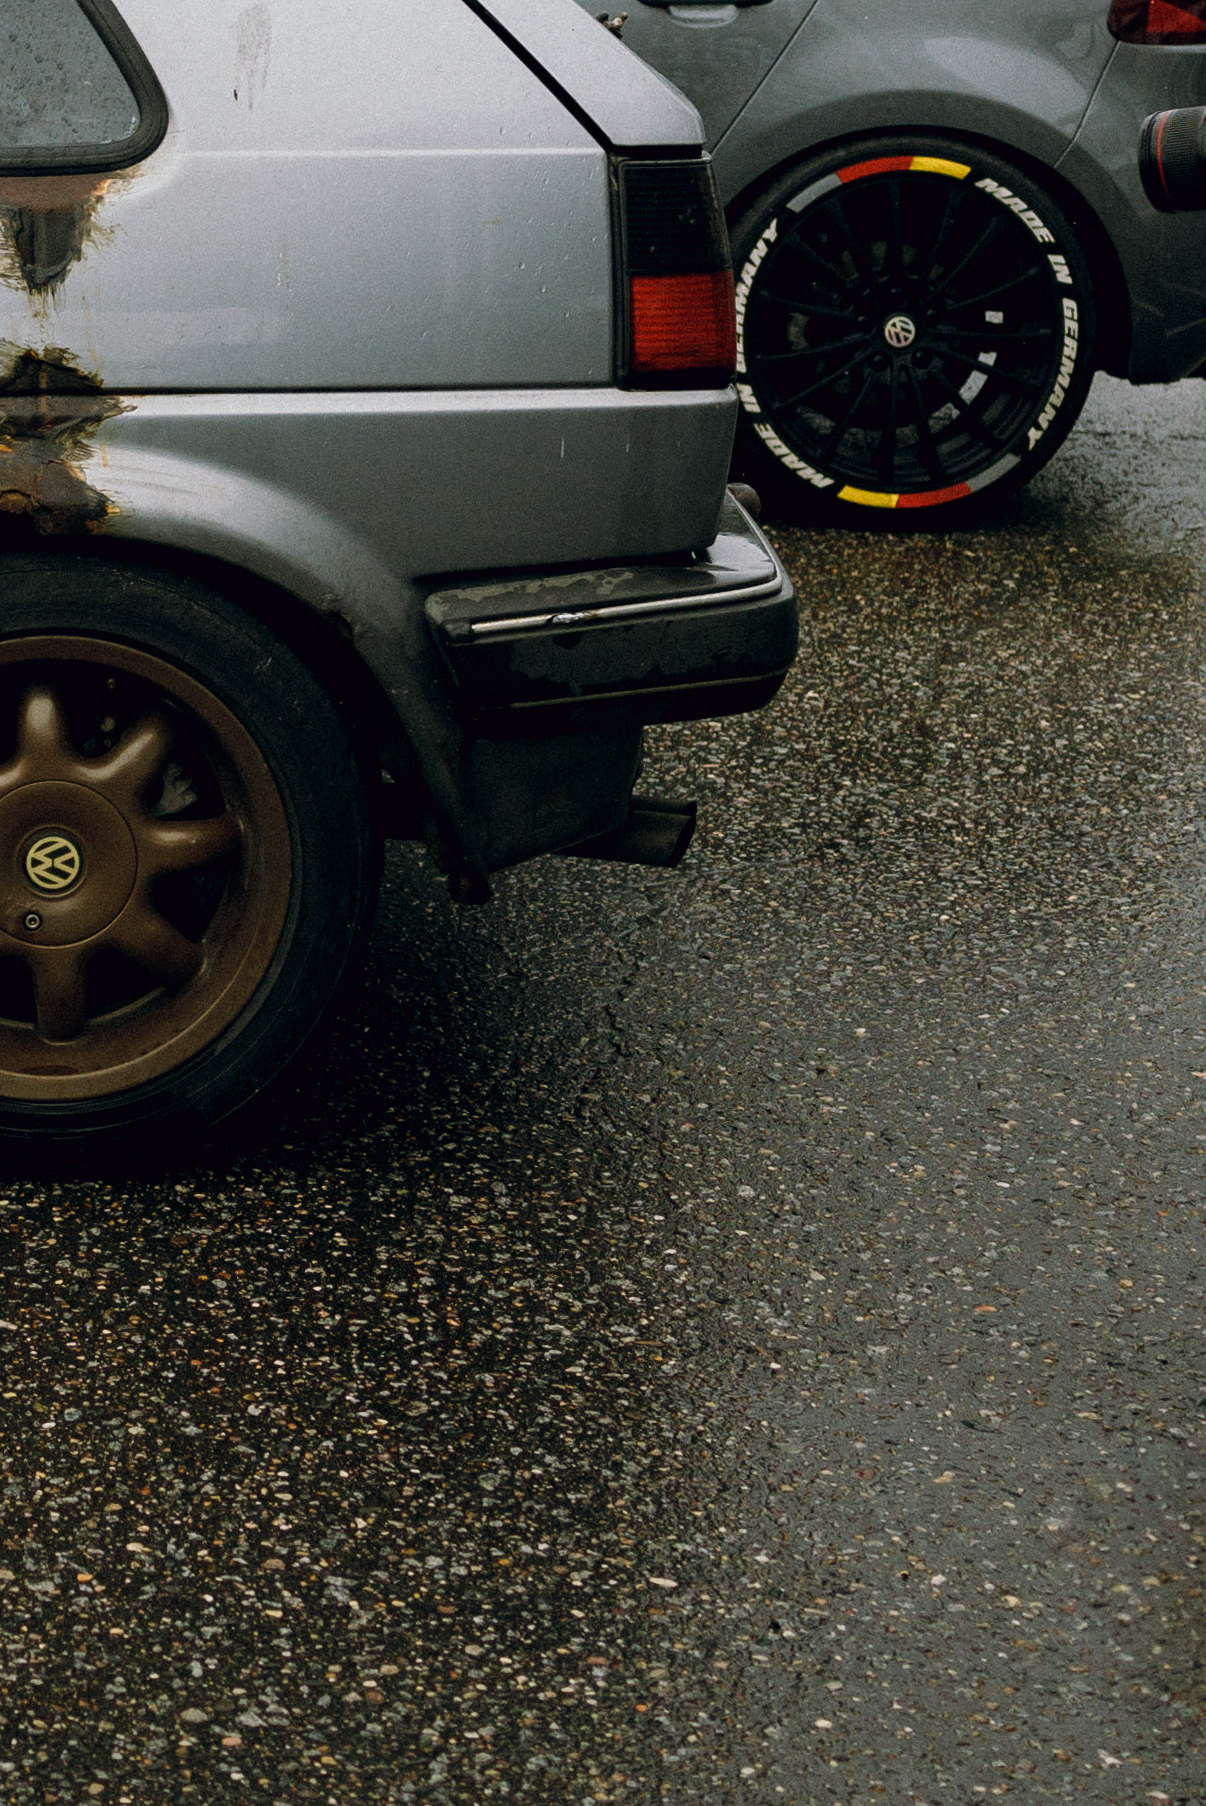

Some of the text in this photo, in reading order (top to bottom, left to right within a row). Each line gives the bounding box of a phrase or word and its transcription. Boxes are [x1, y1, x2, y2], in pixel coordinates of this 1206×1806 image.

[974, 177, 1079, 451] MADE IN GERMANY
[735, 382, 762, 413] IN
[753, 422, 835, 488] MADE
